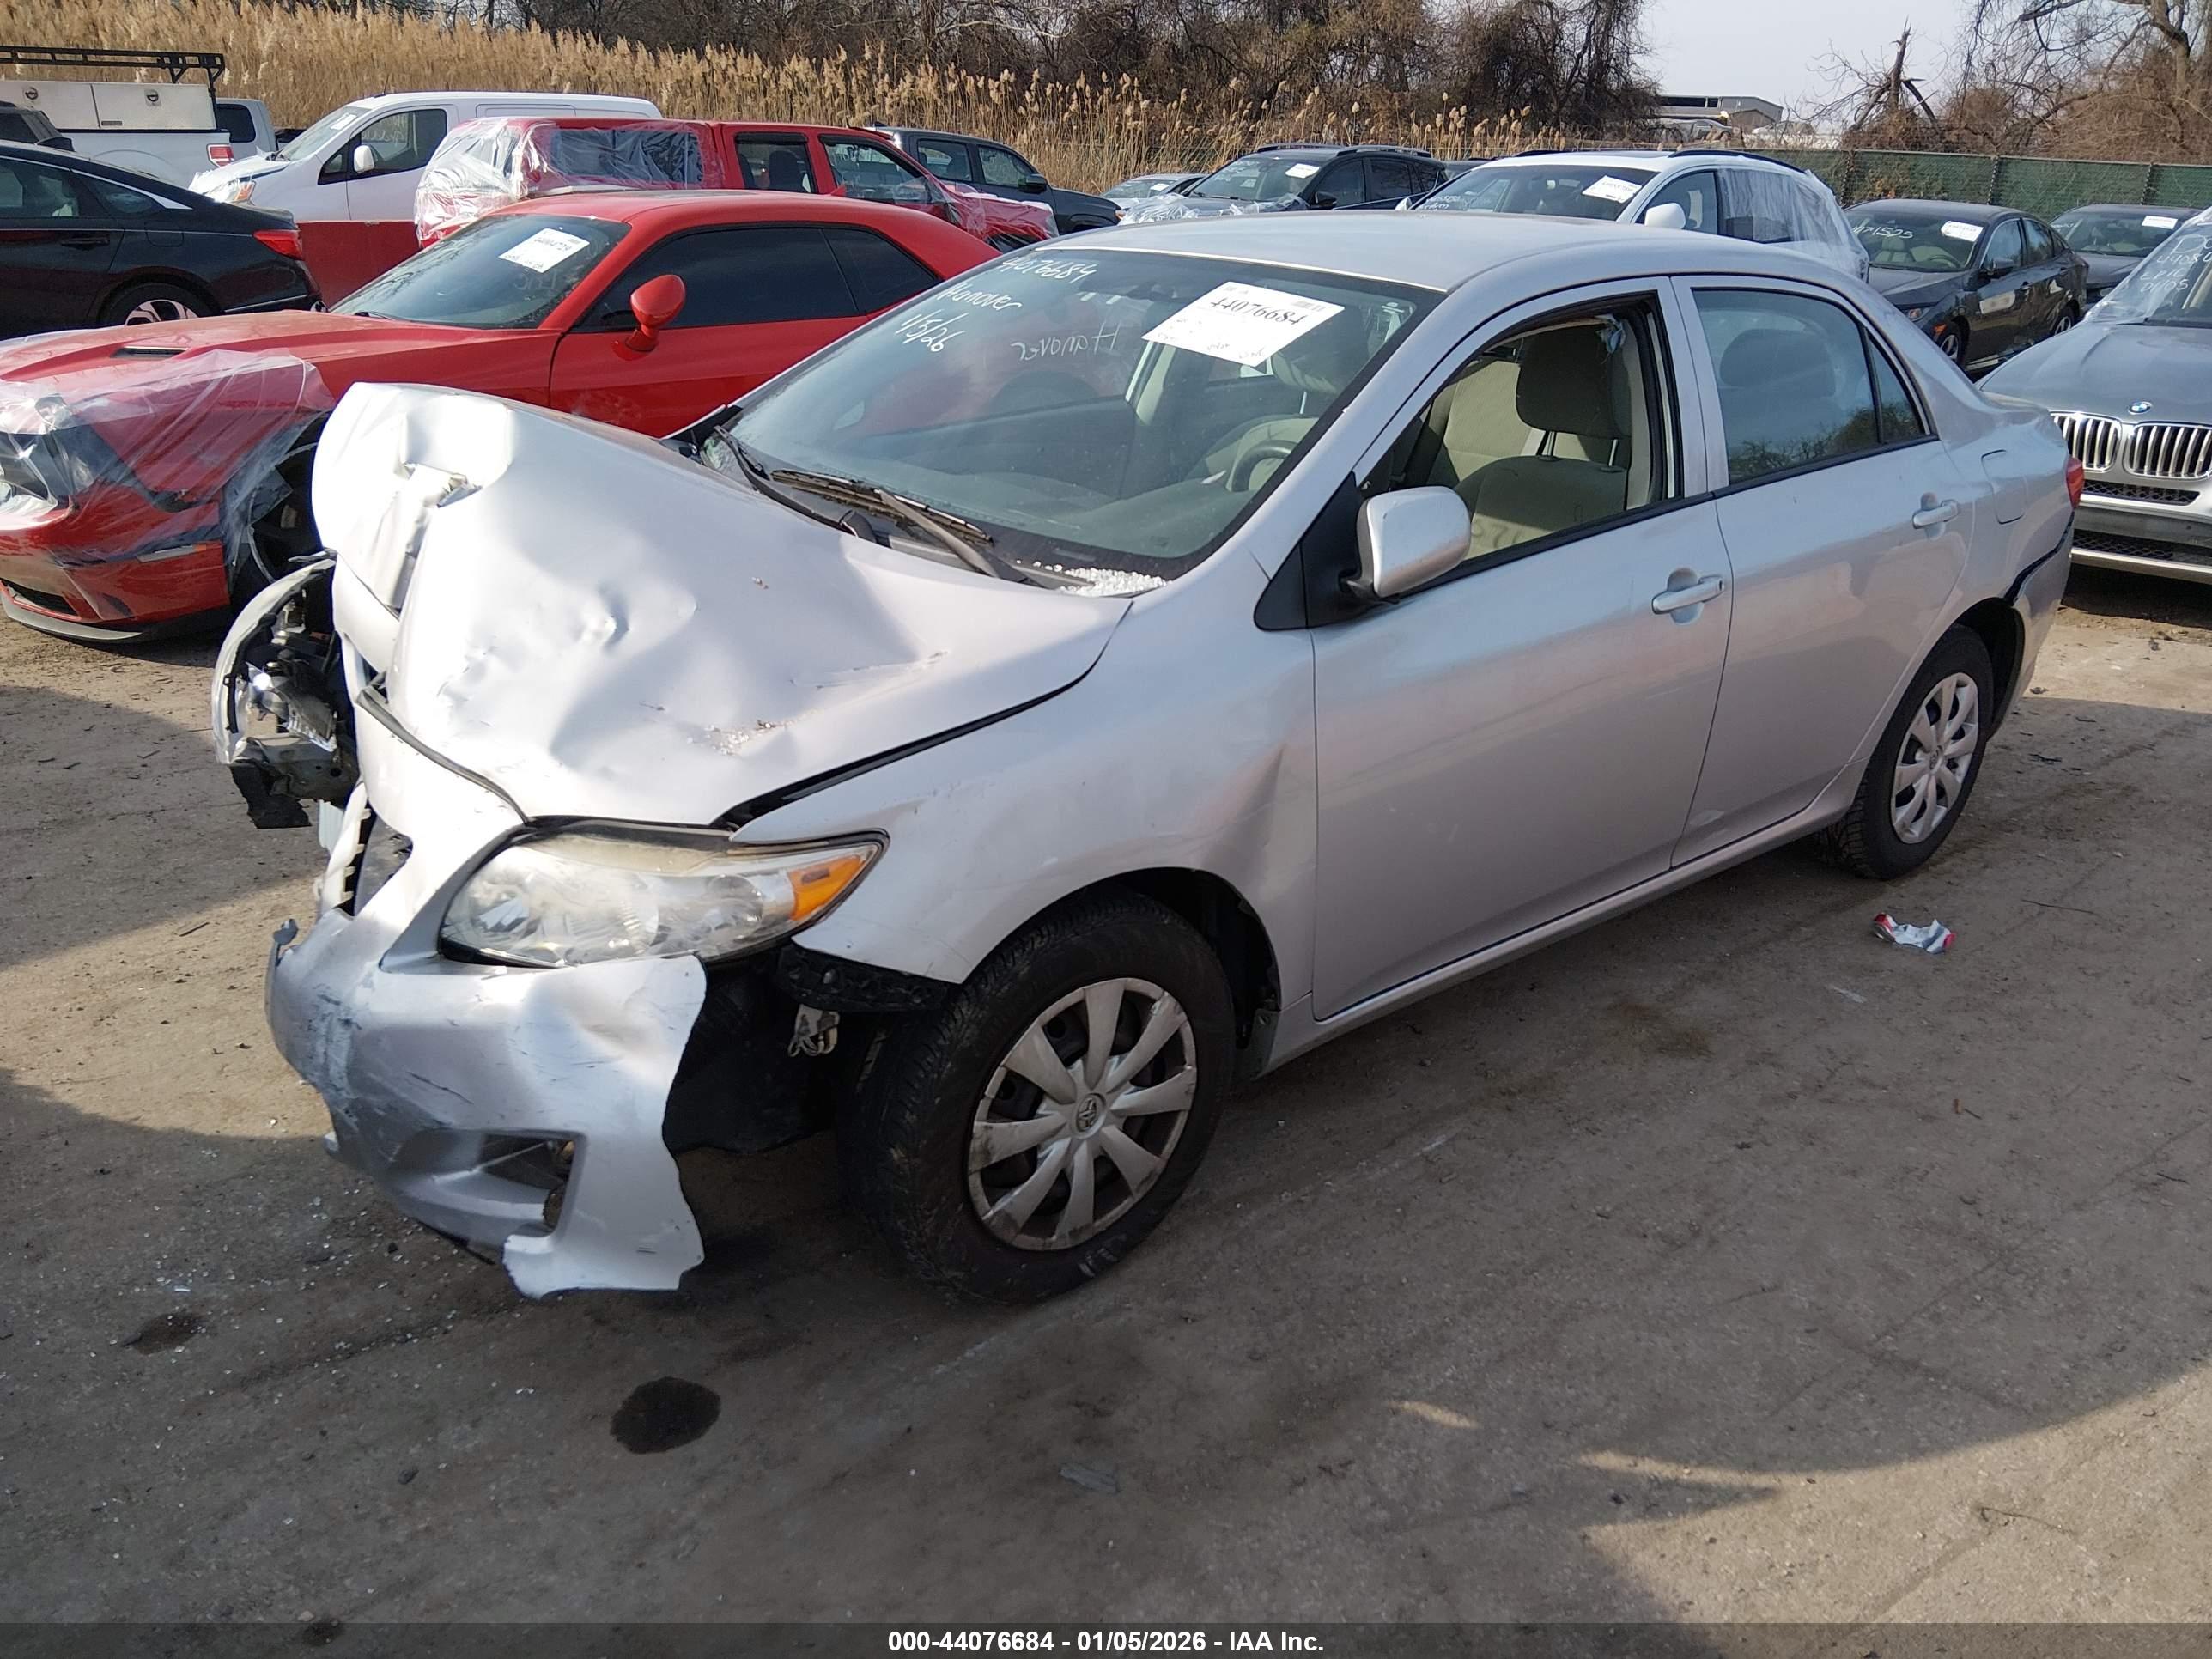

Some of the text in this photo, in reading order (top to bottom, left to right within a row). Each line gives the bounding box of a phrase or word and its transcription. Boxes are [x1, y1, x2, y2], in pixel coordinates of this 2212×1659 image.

[936, 283, 1023, 311] Hanover
[1210, 296, 1308, 325] 44076684
[896, 309, 965, 352] 1/5/26
